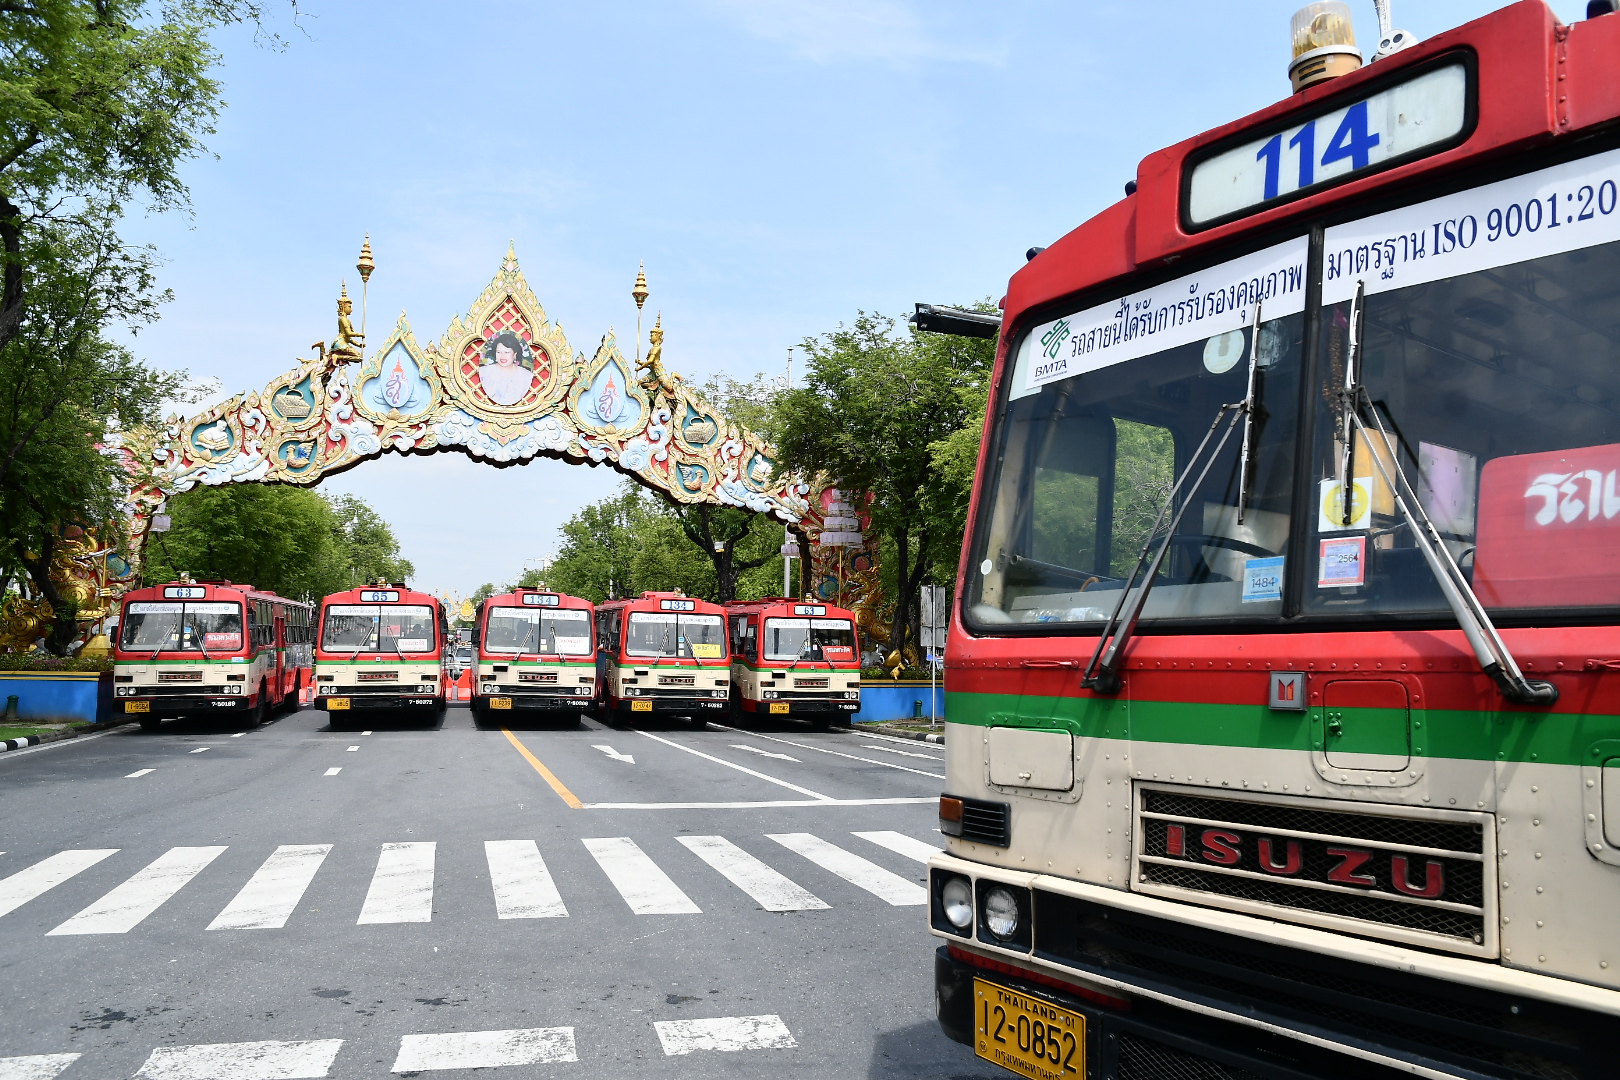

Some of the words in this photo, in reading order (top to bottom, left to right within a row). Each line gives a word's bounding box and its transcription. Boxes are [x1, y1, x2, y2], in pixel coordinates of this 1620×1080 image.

[1256, 101, 1380, 200] 114
[1070, 262, 1302, 358] รถสายนี้ได้รับการรับรองคุณภาพ
[1327, 229, 1425, 280] มาตรฐาน
[1431, 215, 1477, 257] ISO
[1486, 179, 1618, 242] 9001:20
[1034, 359, 1068, 378] BMTA
[1251, 577, 1276, 589] 1484
[176, 588, 192, 598] 63
[371, 592, 388, 602] 65
[530, 595, 552, 605] 134
[669, 601, 687, 610] 134
[804, 607, 815, 616] 63
[1165, 823, 1444, 900] ISUZU
[997, 990, 1058, 1022] THAILAND
[1065, 1015, 1076, 1030] 01
[984, 999, 1077, 1074] 12-0852
